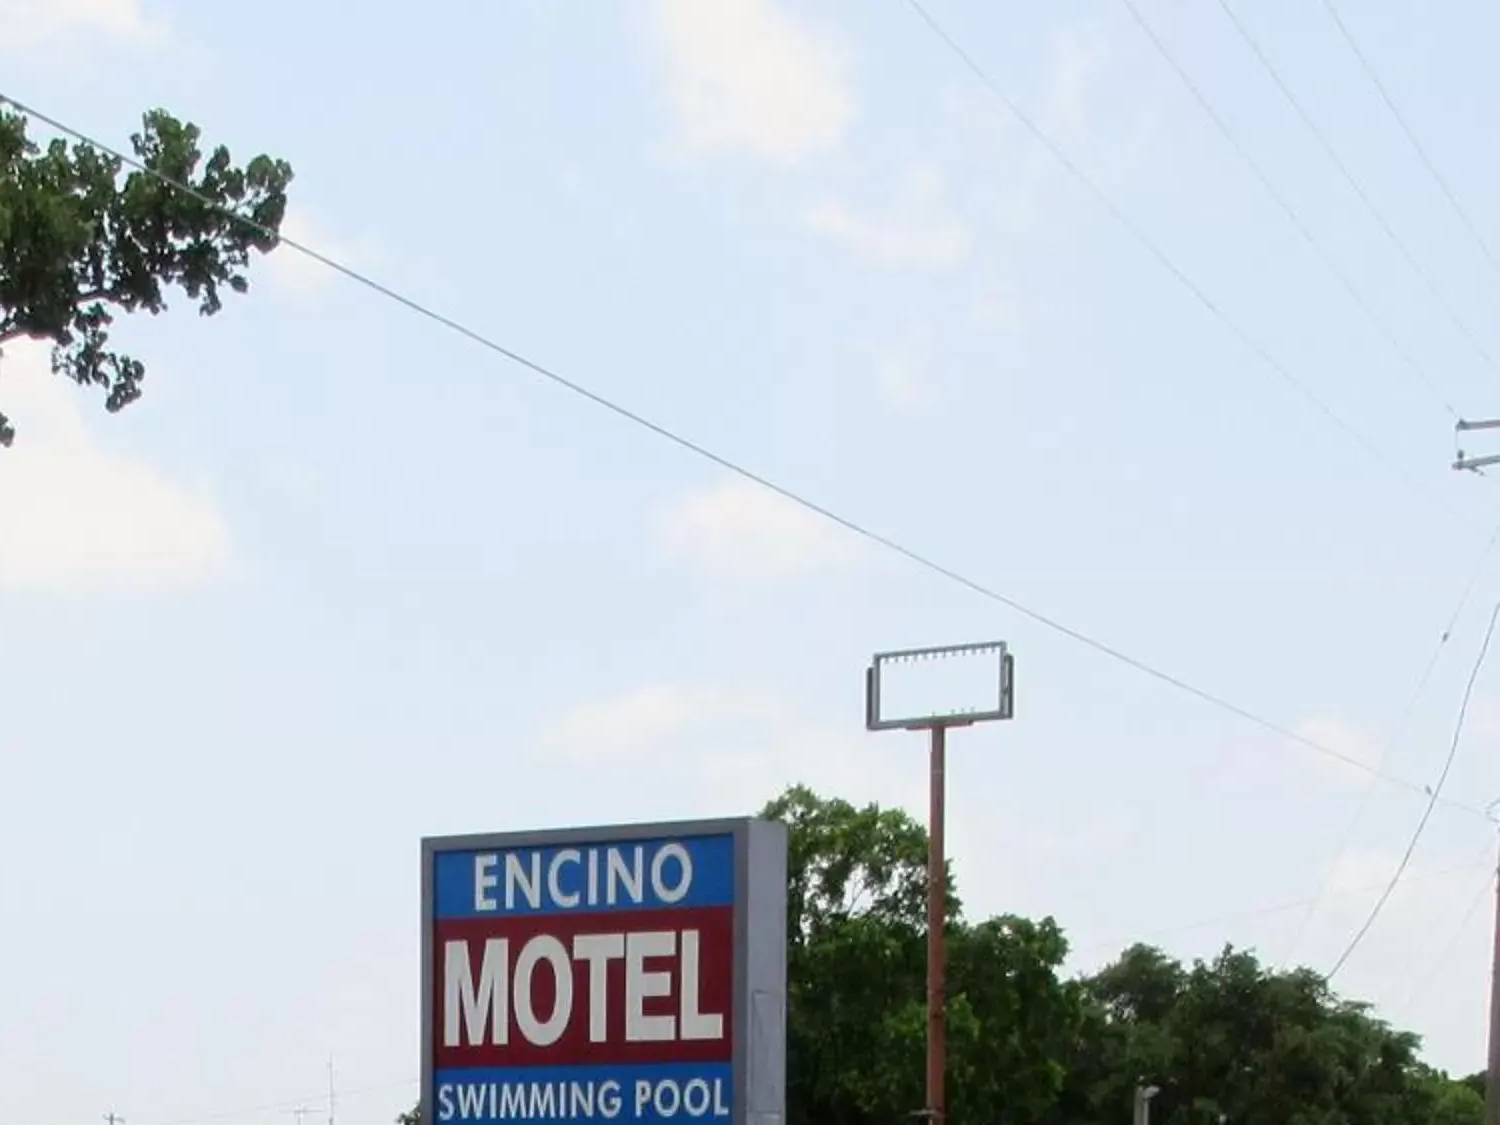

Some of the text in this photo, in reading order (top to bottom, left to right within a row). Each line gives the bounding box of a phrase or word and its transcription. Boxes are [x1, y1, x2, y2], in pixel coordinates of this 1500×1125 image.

[474, 842, 693, 912] ENCINO
[443, 929, 724, 1047] MOTEL
[438, 1077, 729, 1120] SWIMMING POOL
